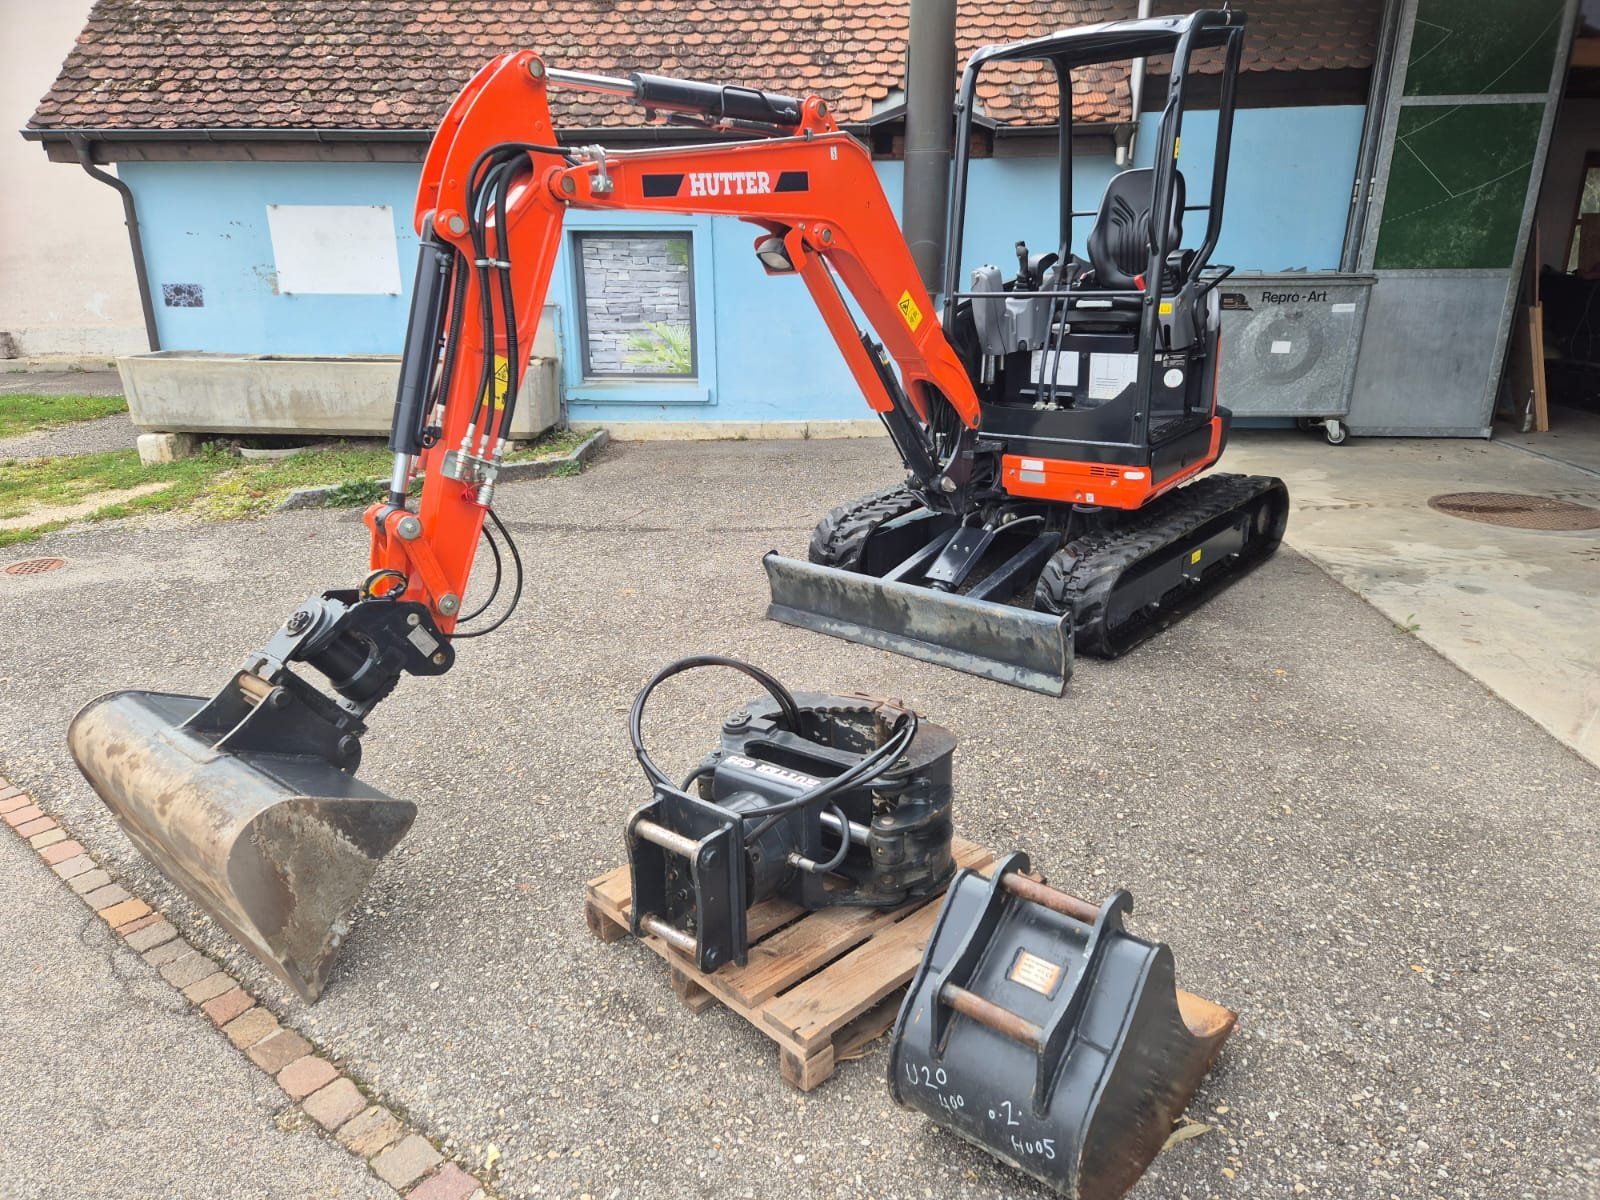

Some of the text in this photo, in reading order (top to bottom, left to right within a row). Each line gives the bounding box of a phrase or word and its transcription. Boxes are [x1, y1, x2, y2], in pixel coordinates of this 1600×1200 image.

[689, 171, 771, 197] HUTTER
[905, 1063, 948, 1090] U20
[938, 1093, 965, 1114] 400
